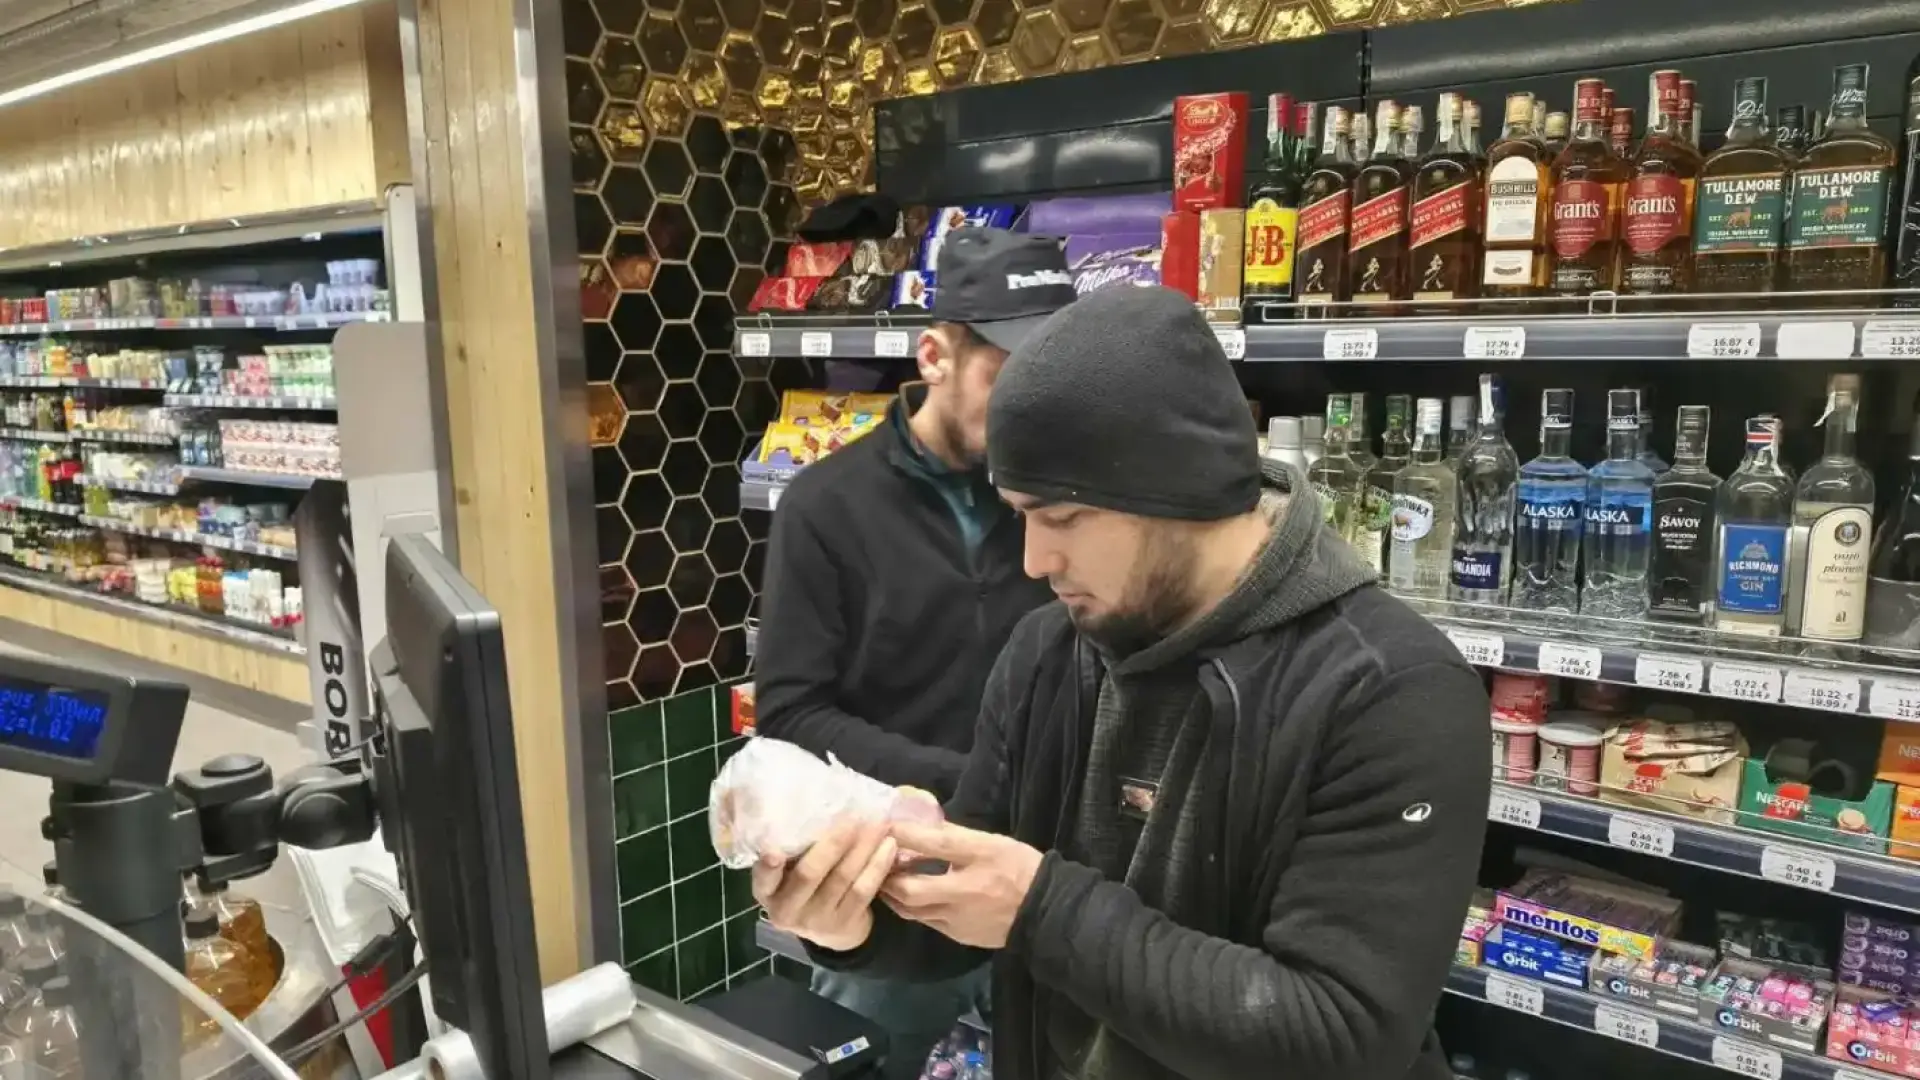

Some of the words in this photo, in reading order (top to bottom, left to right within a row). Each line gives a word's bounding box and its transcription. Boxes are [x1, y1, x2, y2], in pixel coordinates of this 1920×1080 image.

[1705, 179, 1781, 194] TULLAMORE
[1800, 170, 1880, 188] TULLAMORE
[1490, 183, 1537, 194] BUSHMILLS
[1370, 205, 1400, 221] LABEL
[1433, 200, 1464, 217] LABEL
[1554, 200, 1600, 220] Grant's
[1627, 195, 1676, 216] Grant's
[1713, 338, 1741, 347] 16.87
[1523, 504, 1574, 519] ALASKA
[1660, 515, 1701, 528] SAVOY
[1729, 561, 1779, 574] RICHMOND
[1740, 581, 1764, 592] GIN
[1811, 688, 1841, 700] 10.22
[1810, 697, 1840, 709] 19.99
[1630, 839, 1651, 850] 0.78
[1786, 864, 1810, 875] 0.40
[1785, 873, 1809, 883] 0.78
[1505, 906, 1599, 943] mentos
[1502, 951, 1540, 972] Orbit
[1611, 980, 1650, 999] Orbit
[1719, 1012, 1762, 1034] Orbit
[1850, 1043, 1897, 1064] Orbit
